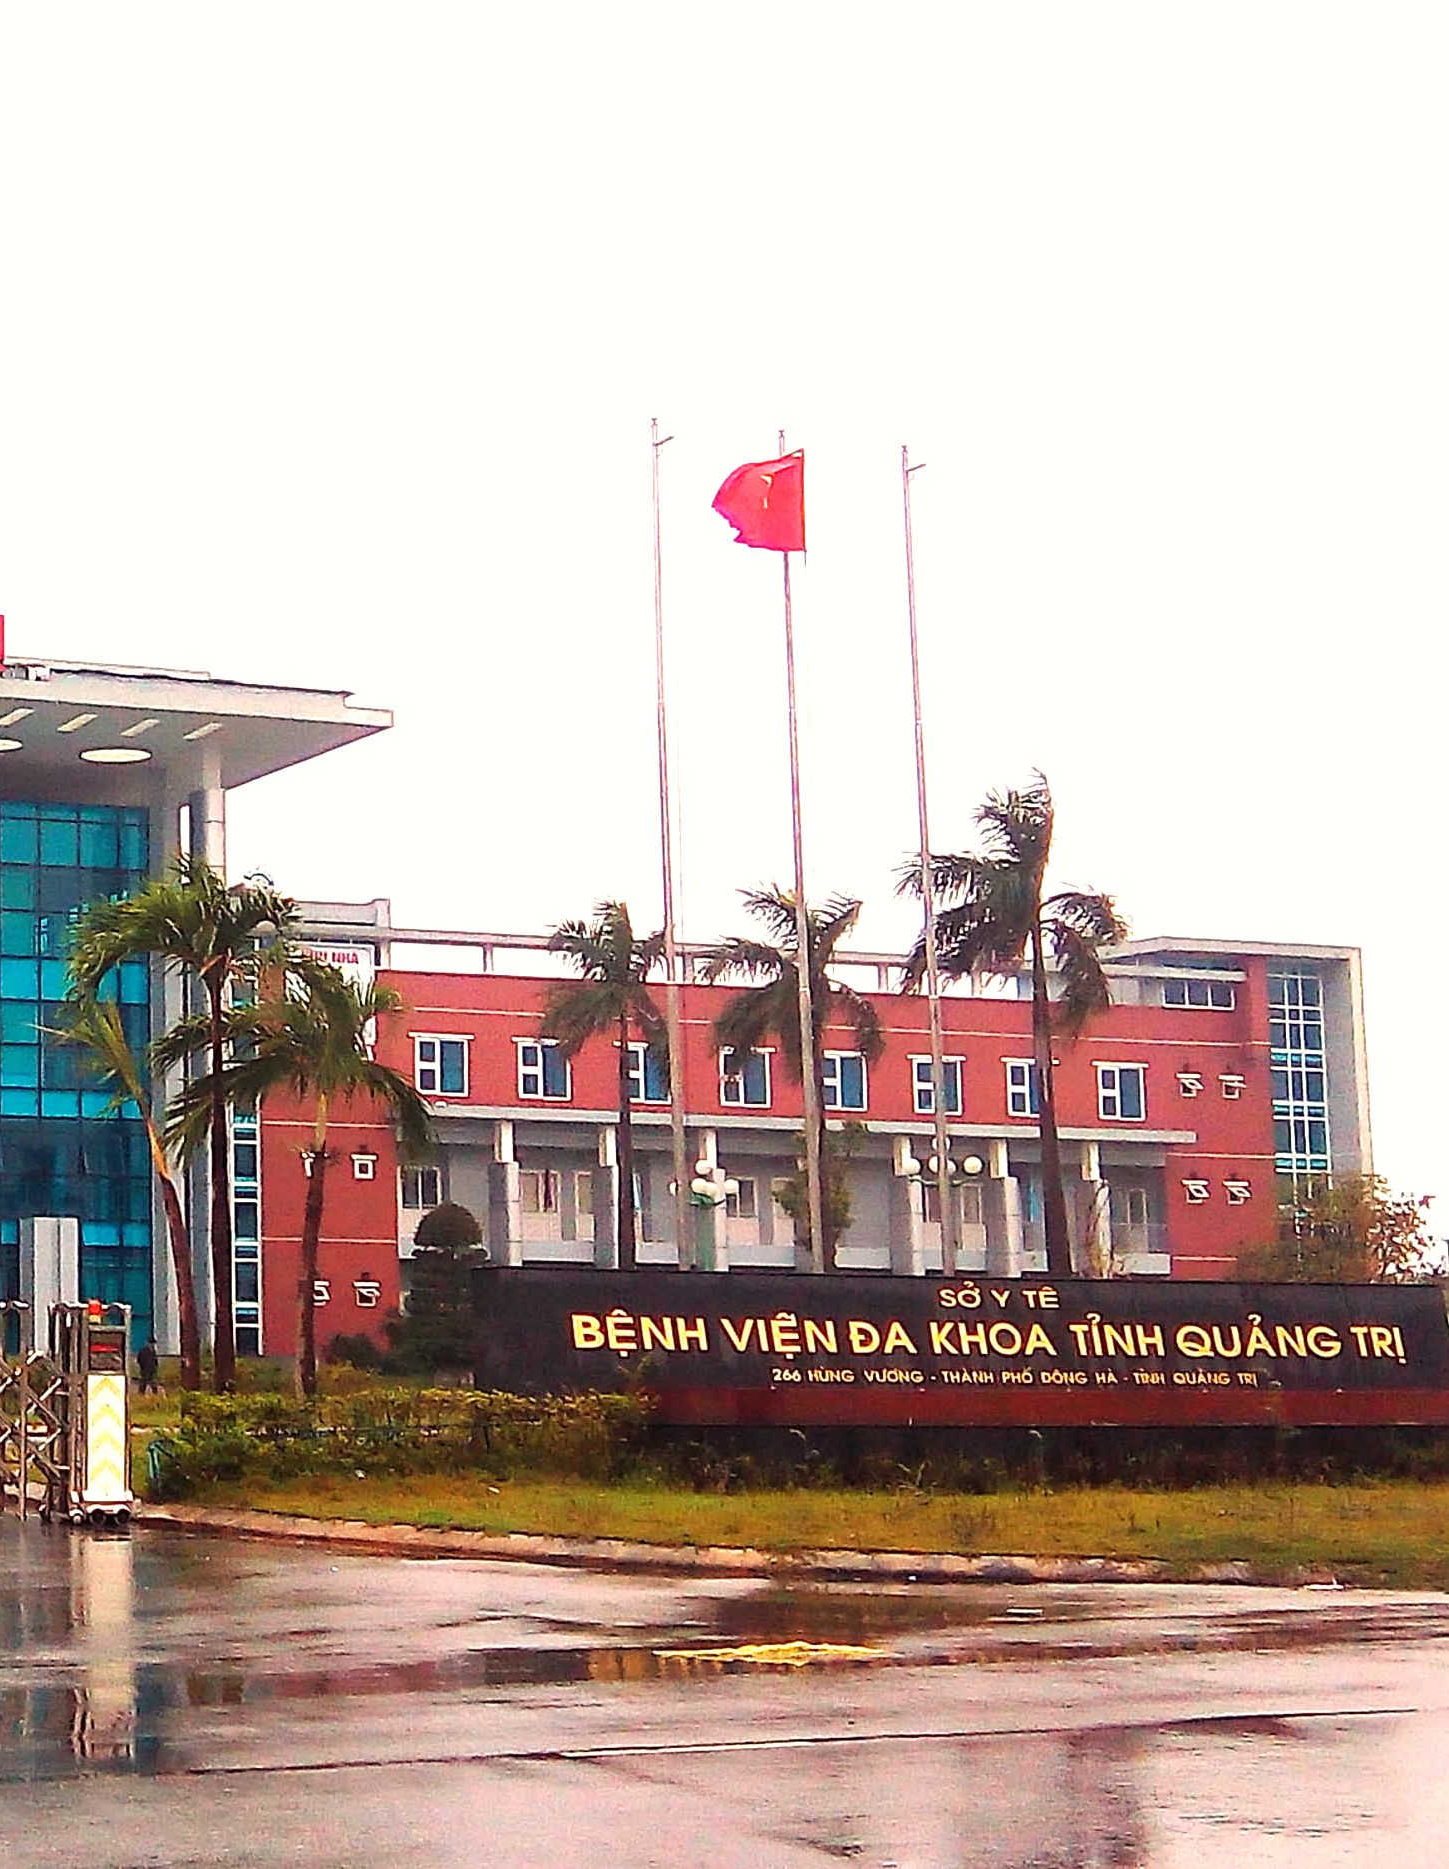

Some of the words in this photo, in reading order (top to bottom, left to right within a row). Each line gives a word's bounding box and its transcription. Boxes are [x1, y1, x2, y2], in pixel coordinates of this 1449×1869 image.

[939, 1280, 981, 1308] SỞ
[990, 1289, 1011, 1308] Y
[571, 1308, 709, 1358] BỆNH
[720, 1312, 838, 1360] VIỆN
[848, 1320, 918, 1354] ĐA
[929, 1321, 1058, 1356] KHOA
[1069, 1313, 1165, 1357] TỈNH
[1176, 1314, 1342, 1358] QUẢNG
[1350, 1326, 1407, 1364] TRỊ
[771, 1368, 802, 1382] 266
[940, 1367, 994, 1384] THÀNH
